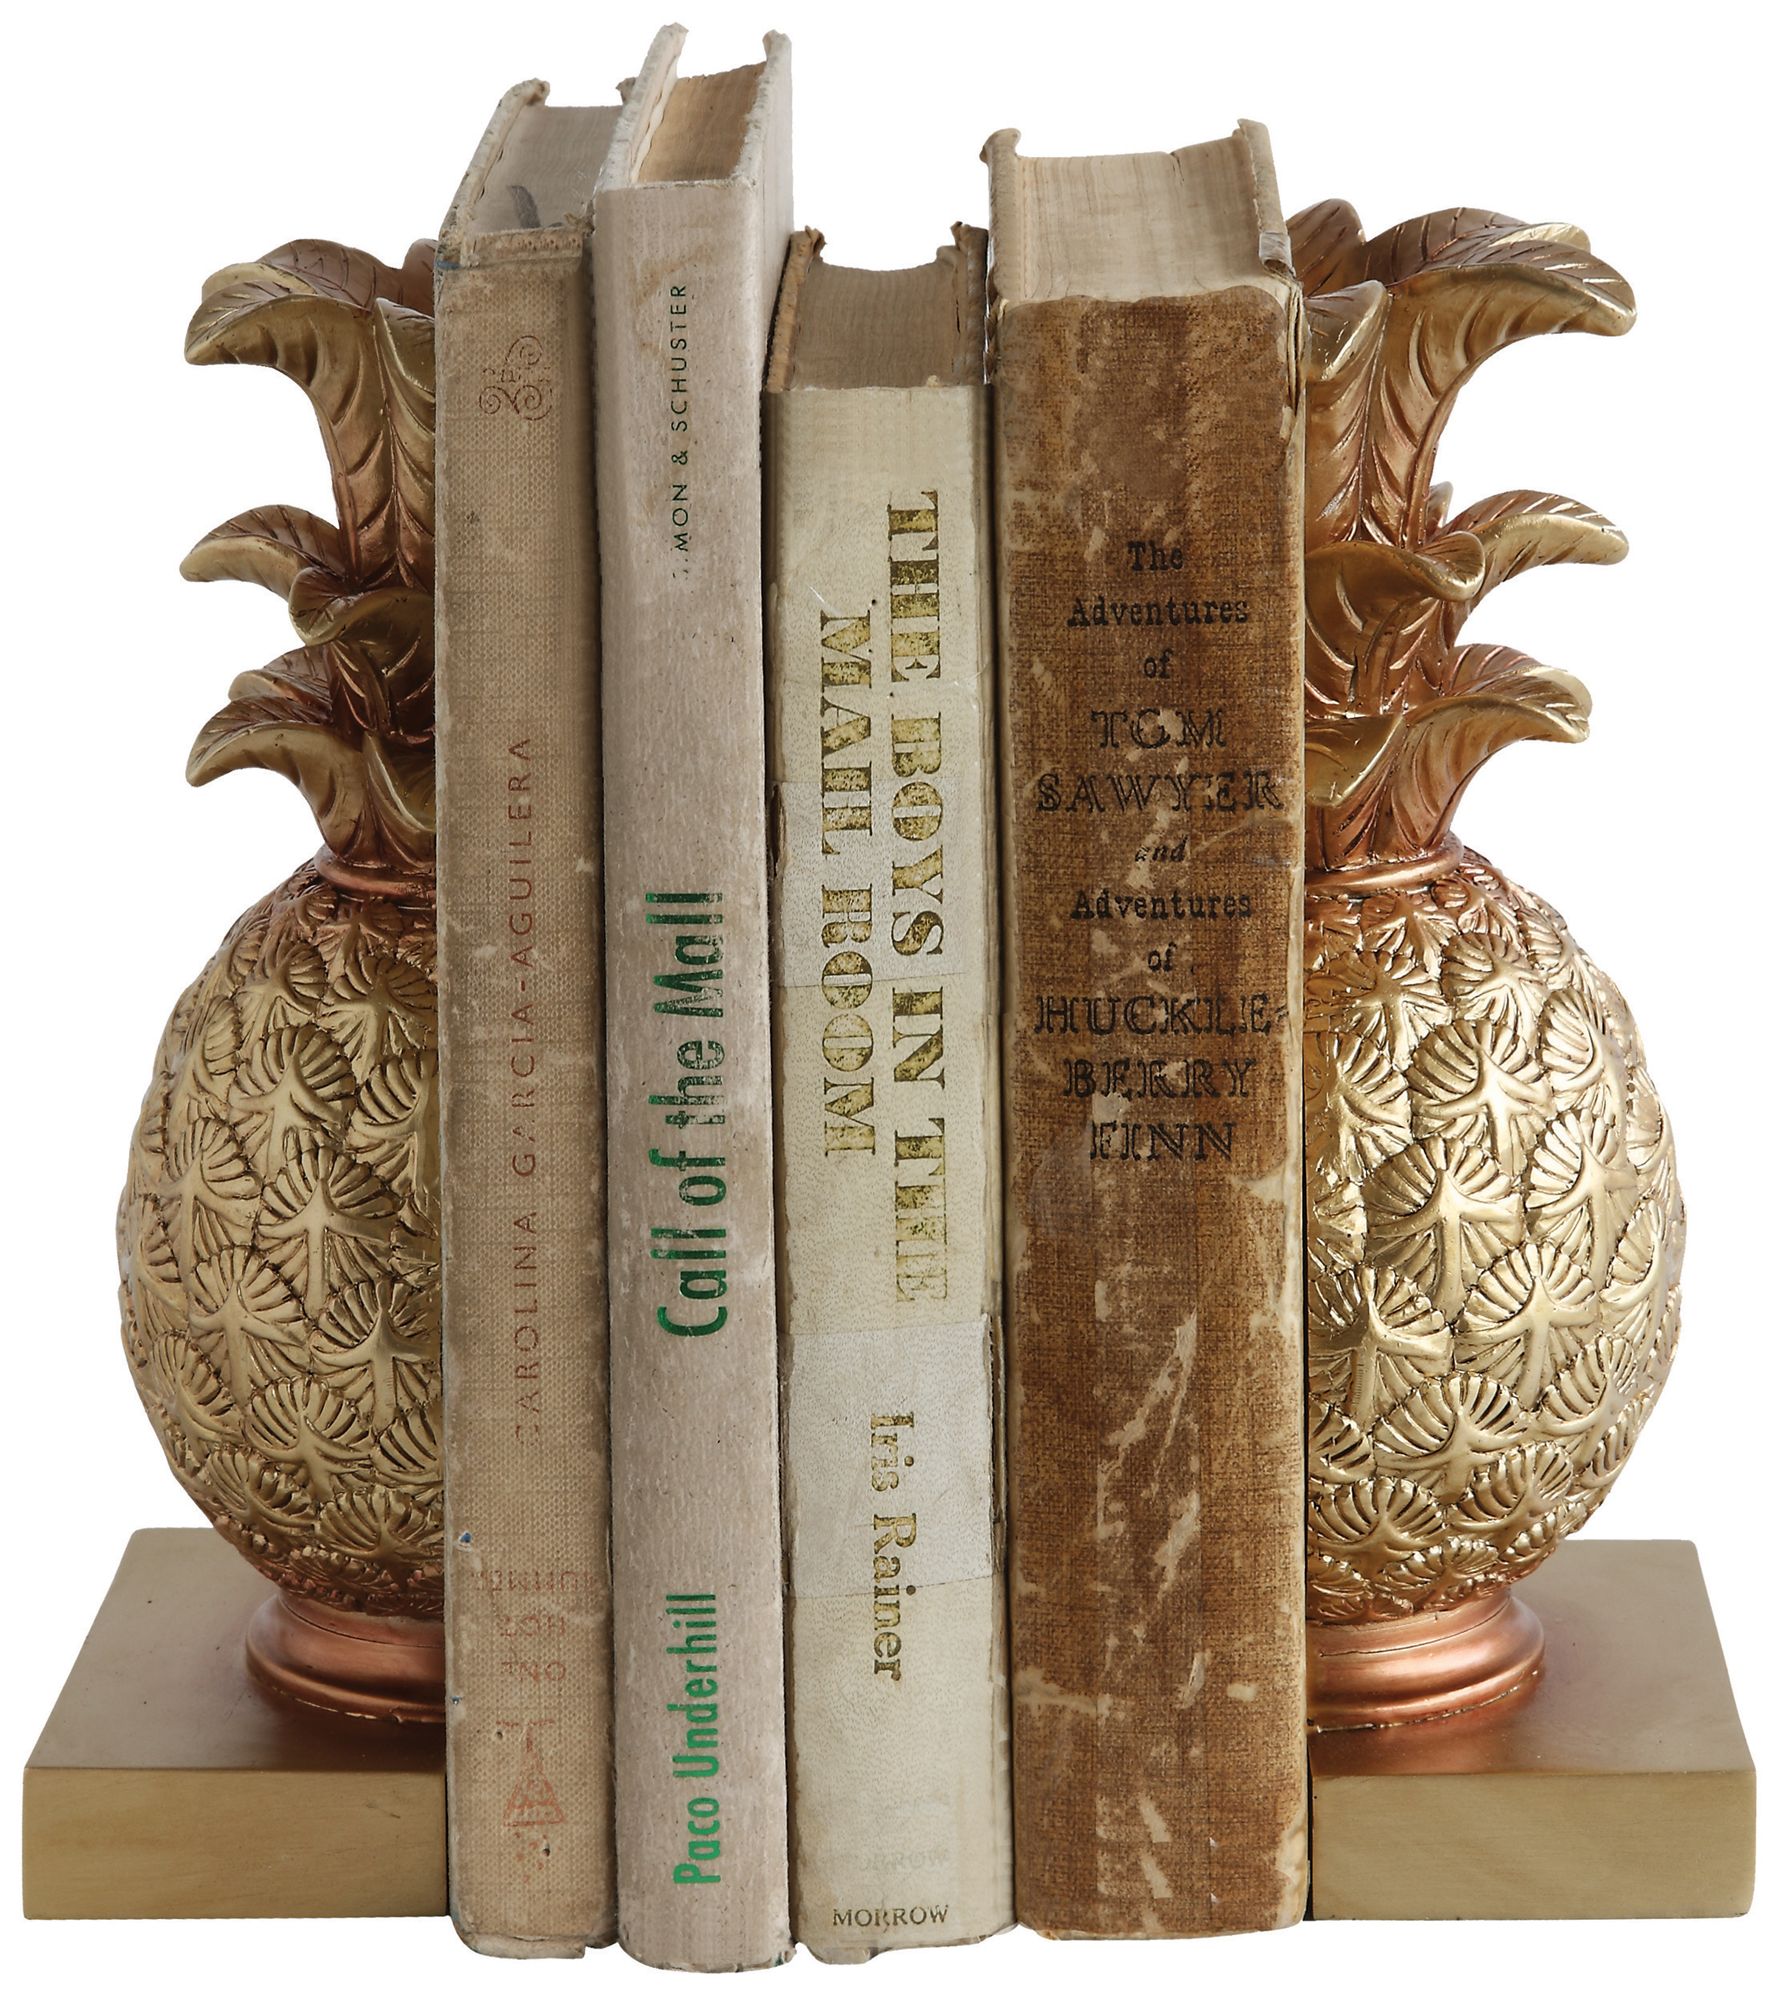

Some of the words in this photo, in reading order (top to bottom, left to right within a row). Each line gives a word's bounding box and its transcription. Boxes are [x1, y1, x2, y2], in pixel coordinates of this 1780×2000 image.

[670, 285, 688, 432] SCHUSTER
[671, 450, 688, 466] &
[887, 490, 941, 683] THE
[1127, 540, 1185, 572] The
[1067, 596, 1250, 628] Adventures
[1143, 648, 1174, 680] of
[819, 609, 874, 856] MAIL
[1090, 706, 1228, 750] TOM
[890, 711, 945, 956] BOYS
[1035, 769, 1285, 814] SAWYER
[1134, 834, 1189, 863] and
[1070, 887, 1254, 921] Adventures
[507, 737, 537, 1178] GARCIA-AGUILERA
[644, 892, 725, 1018] Mall
[1147, 941, 1179, 973] of
[821, 882, 877, 1157] ROOM
[892, 985, 946, 1090] IN
[647, 1040, 726, 1130] the
[1062, 1057, 1257, 1099] BERRY
[648, 1148, 728, 1207] of
[1089, 1119, 1235, 1161] FINN
[894, 1117, 949, 1301] THE
[650, 1227, 729, 1338] Call
[869, 1410, 915, 1492] Iris
[872, 1512, 918, 1682] Rainer
[665, 1593, 721, 1778] Underhill
[672, 1797, 722, 1885] Paco
[832, 1903, 949, 1927] MORROW
